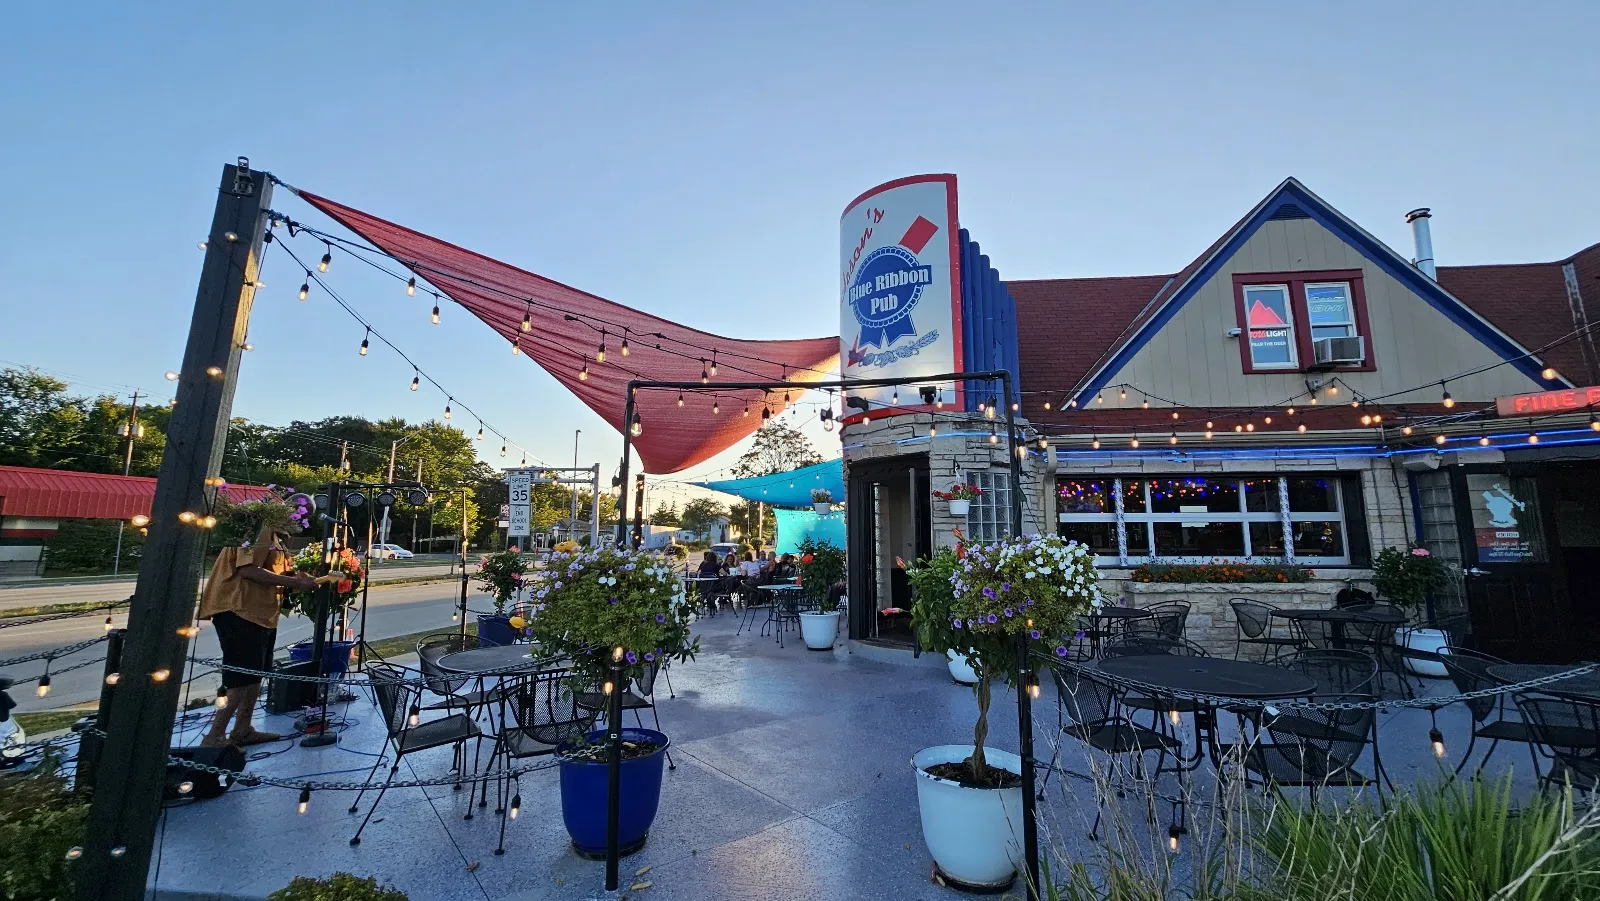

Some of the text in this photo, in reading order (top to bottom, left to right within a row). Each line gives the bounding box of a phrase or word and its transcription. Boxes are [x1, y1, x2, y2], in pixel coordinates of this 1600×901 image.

[849, 268, 930, 304] Blue Ribbon
[870, 293, 899, 315] Pub
[1266, 330, 1287, 338] LIGHT
[1516, 392, 1577, 412] FINE
[512, 490, 528, 501] 35
